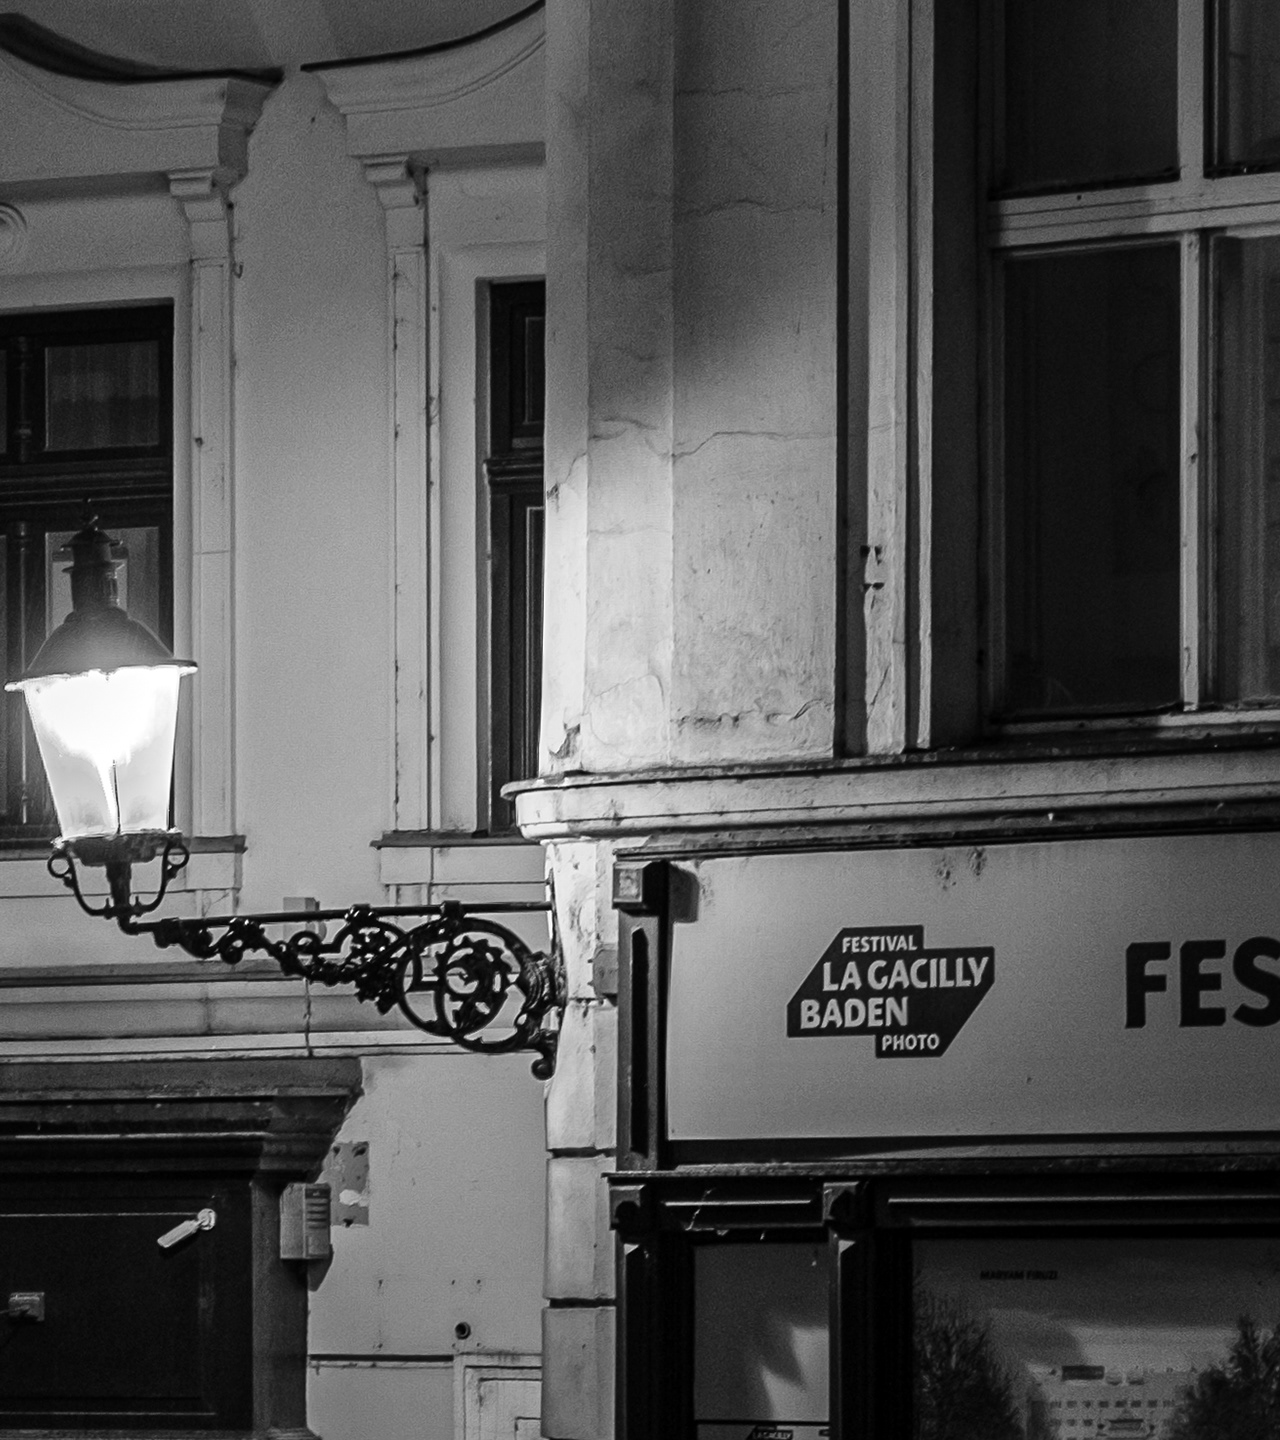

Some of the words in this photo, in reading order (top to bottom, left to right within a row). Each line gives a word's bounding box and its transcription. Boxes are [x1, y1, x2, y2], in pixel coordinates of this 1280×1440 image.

[842, 935, 917, 953] FESTIVAL
[822, 961, 862, 991] LA
[867, 956, 989, 990] GACILLY
[1125, 936, 1280, 1029] FES
[800, 996, 909, 1029] BADEN
[882, 1034, 940, 1051] PHOTO
